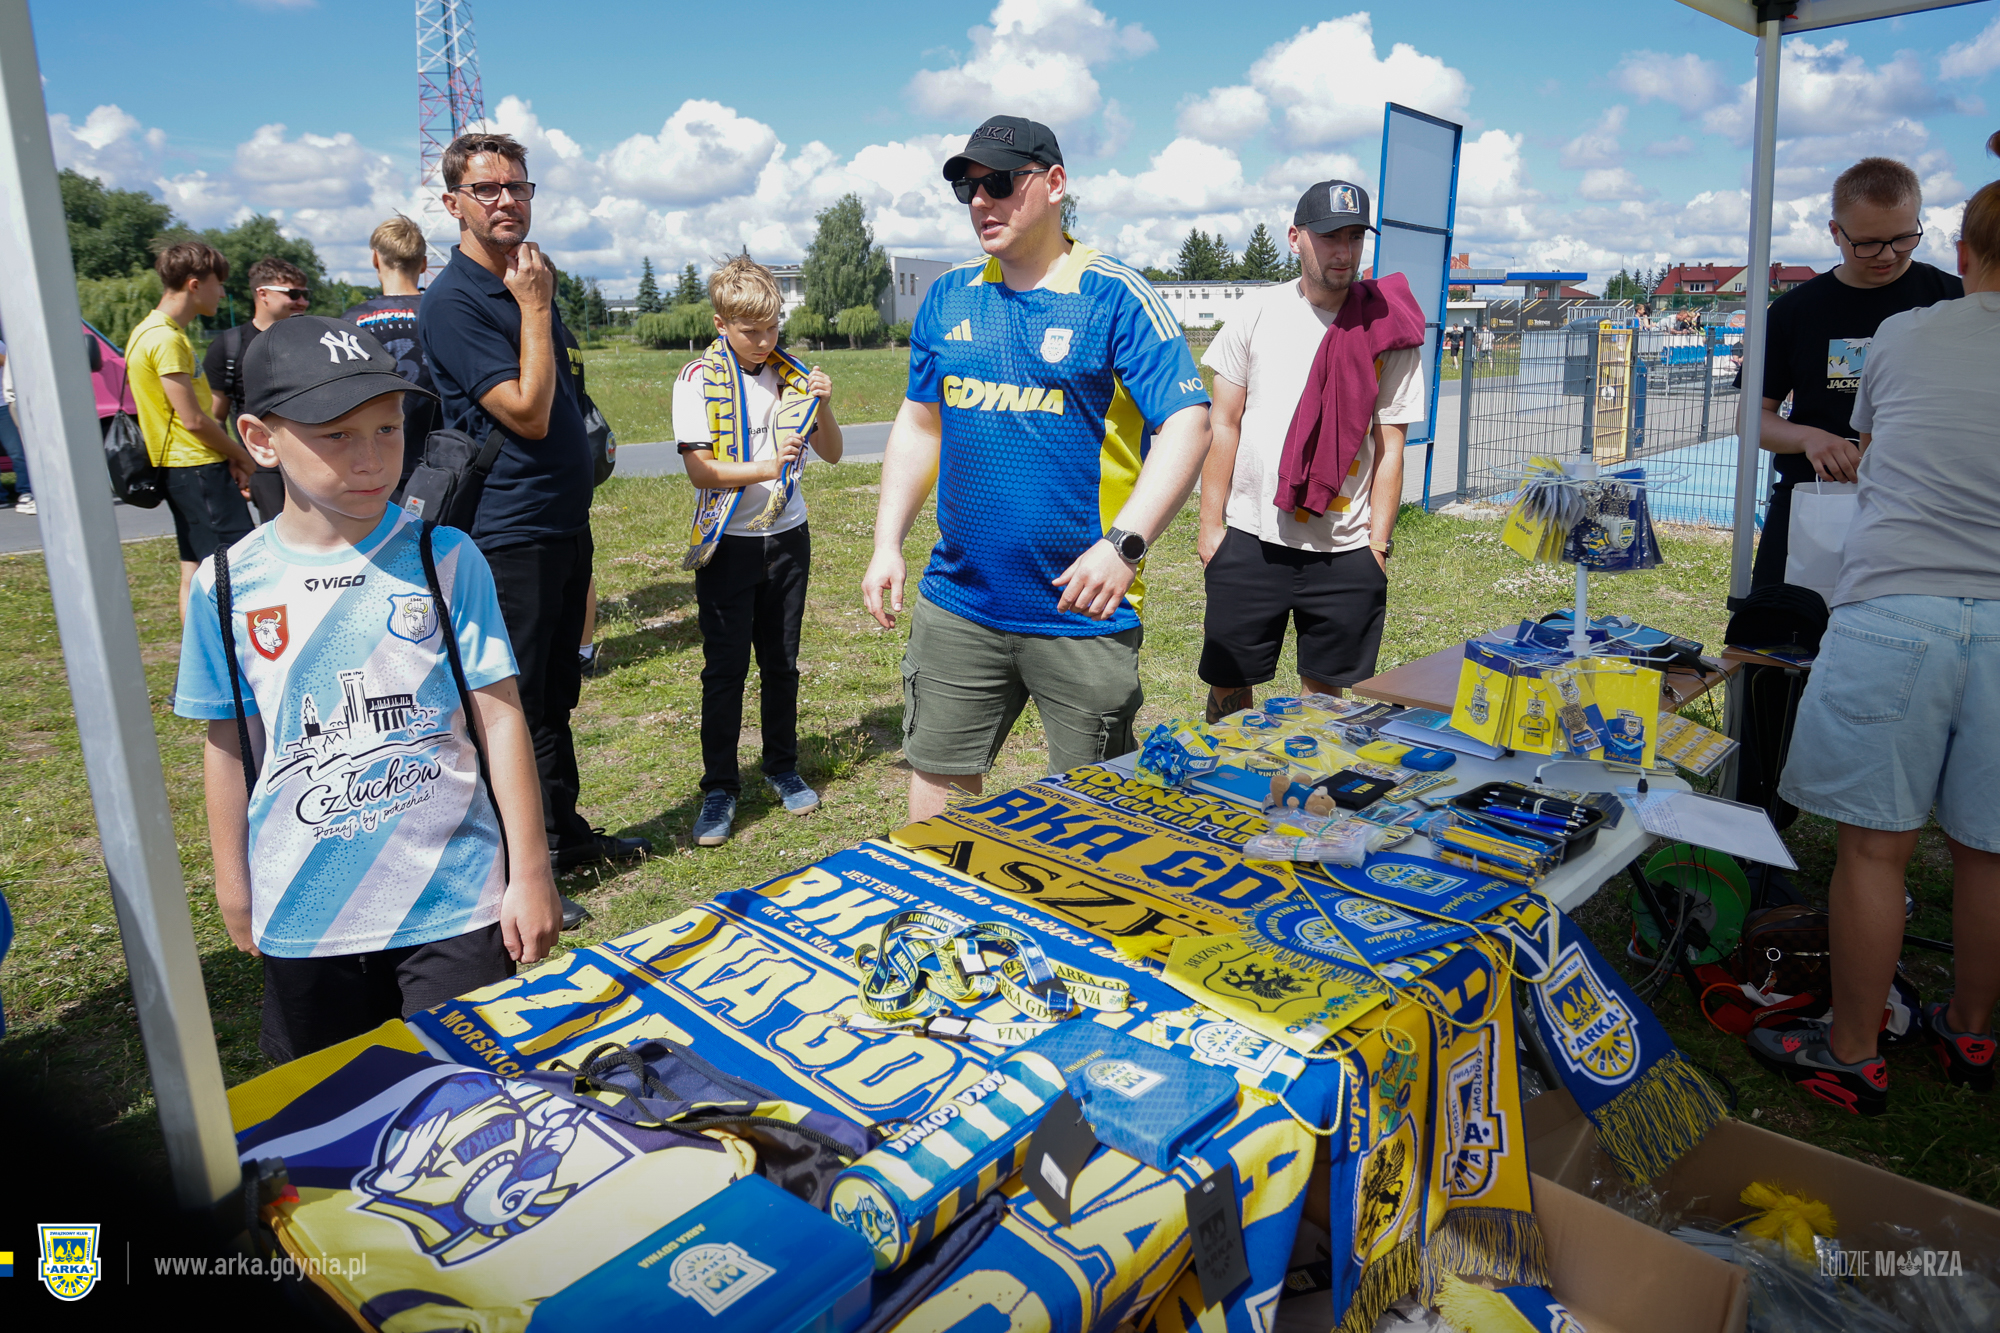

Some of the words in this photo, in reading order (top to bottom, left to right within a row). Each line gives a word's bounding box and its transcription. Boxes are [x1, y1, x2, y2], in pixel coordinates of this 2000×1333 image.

[970, 126, 1015, 146] RKA
[320, 331, 371, 364] NY
[943, 375, 1064, 416] GDYNIA
[1178, 377, 1204, 394] NO
[1062, 780, 1115, 802] ARKA
[1119, 796, 1200, 829] GDYNIA
[1165, 833, 1201, 848] FANI,
[1207, 846, 1235, 857] DLA
[1016, 839, 1047, 850] CZY
[1061, 855, 1092, 867] NAS
[1113, 873, 1161, 890] GDYNI
[1387, 866, 1421, 885] ARKA
[841, 869, 920, 904] JESTEŚMY
[1349, 904, 1385, 918] ARKA
[1439, 891, 1485, 914] Gdynia
[761, 905, 791, 921] MY
[784, 919, 813, 938] ZA
[906, 912, 957, 933] ARKOWCY
[1364, 928, 1416, 945] Gdynia
[1056, 964, 1097, 986] ARKA
[1216, 1028, 1244, 1059] ARKA
[1575, 1011, 1621, 1053] ARKA
[956, 1069, 1007, 1106] ARKA
[456, 1119, 513, 1162] ARKA
[886, 1103, 961, 1154] GDYNIA
[677, 1223, 706, 1246] ARKA
[637, 1241, 679, 1269] GDYNIA
[1203, 1237, 1236, 1268] ARKA
[687, 1254, 728, 1284] ARKA
